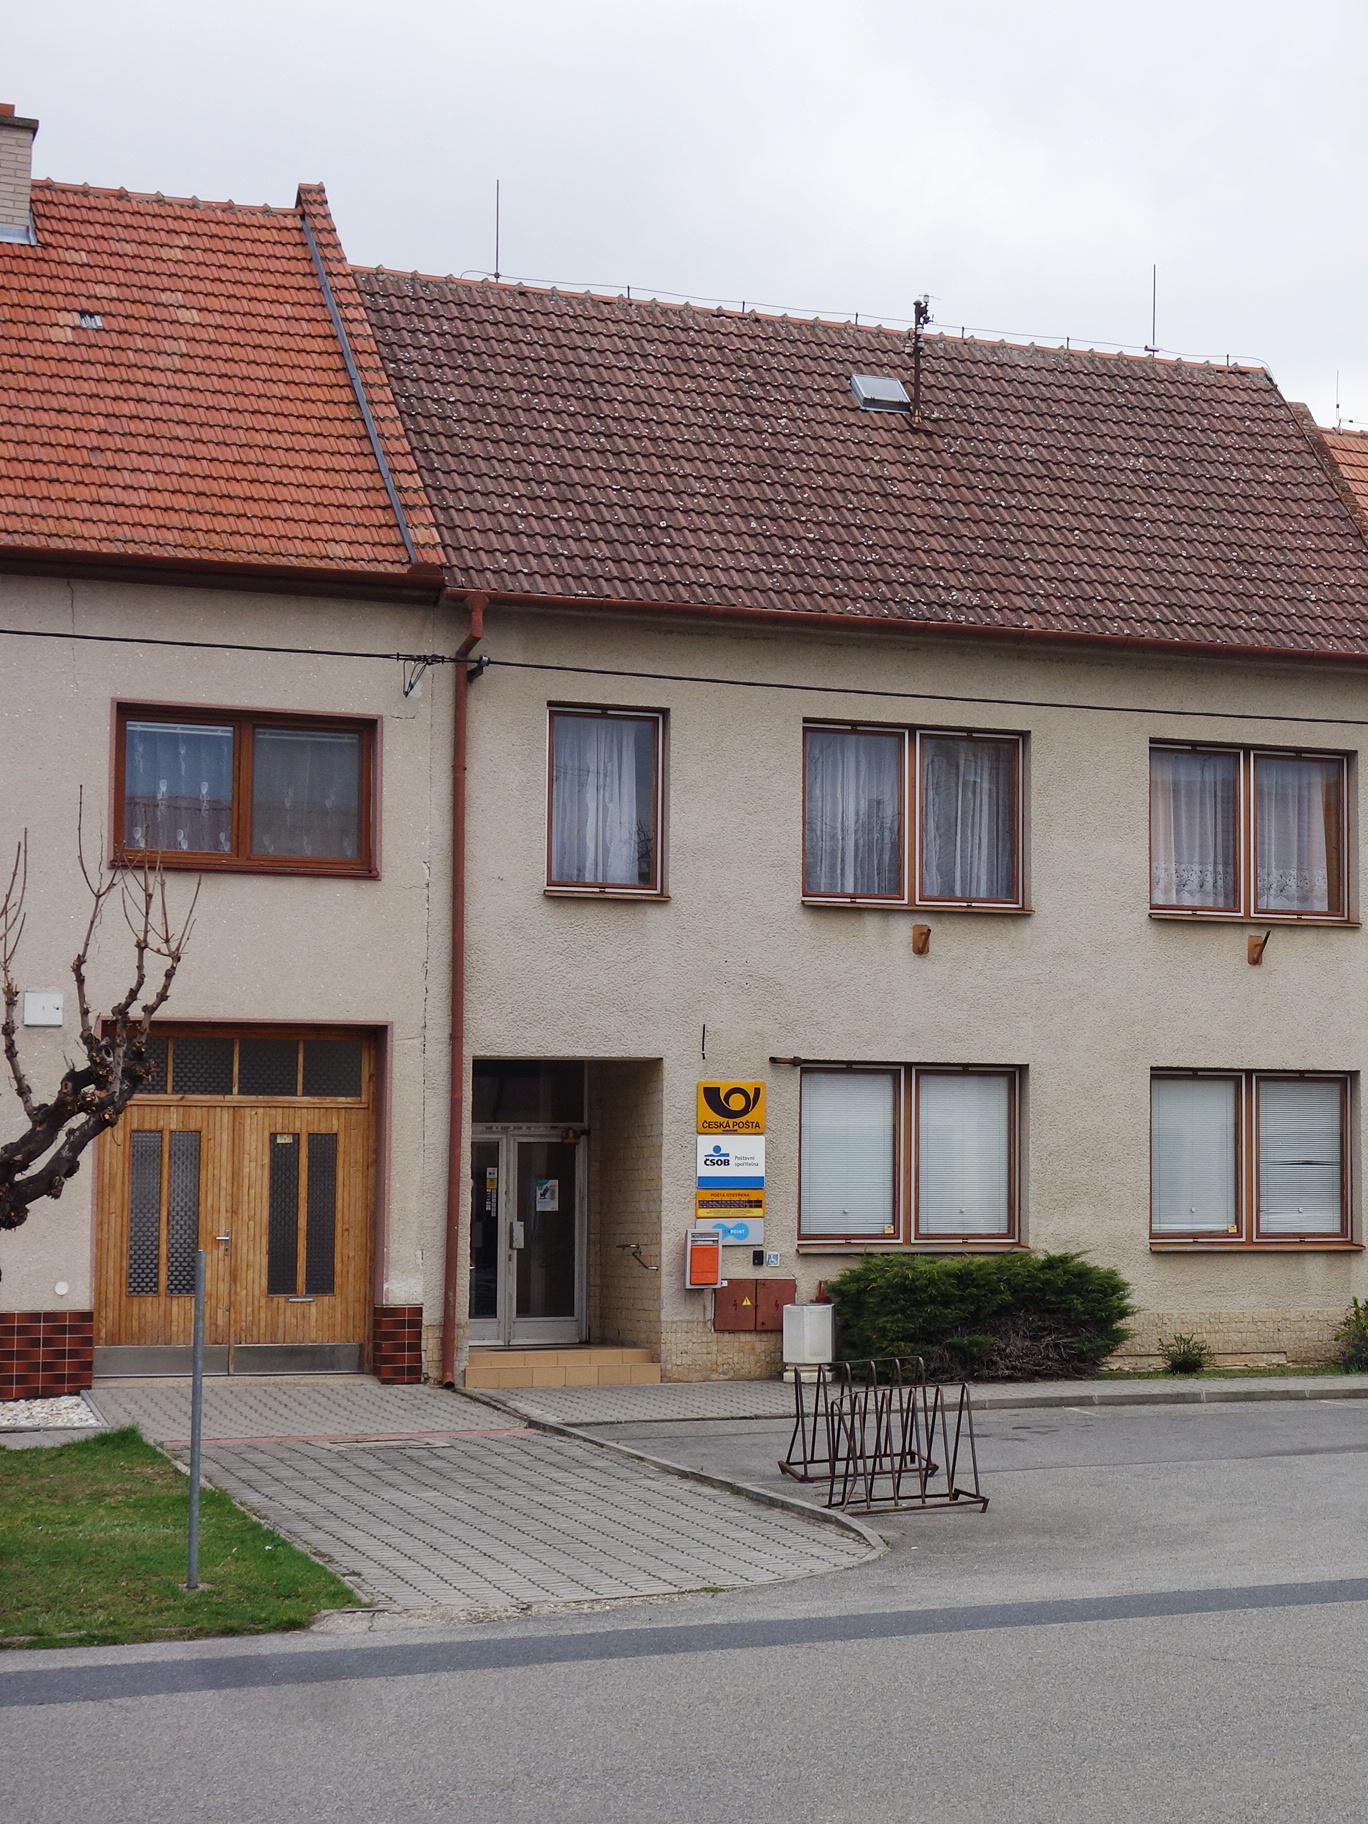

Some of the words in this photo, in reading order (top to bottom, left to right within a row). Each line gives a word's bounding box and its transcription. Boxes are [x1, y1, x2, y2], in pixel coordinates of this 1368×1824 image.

[701, 1120, 731, 1129] ČESKÁ
[732, 1120, 761, 1129] POŠTA
[703, 1158, 730, 1167] ČSOB
